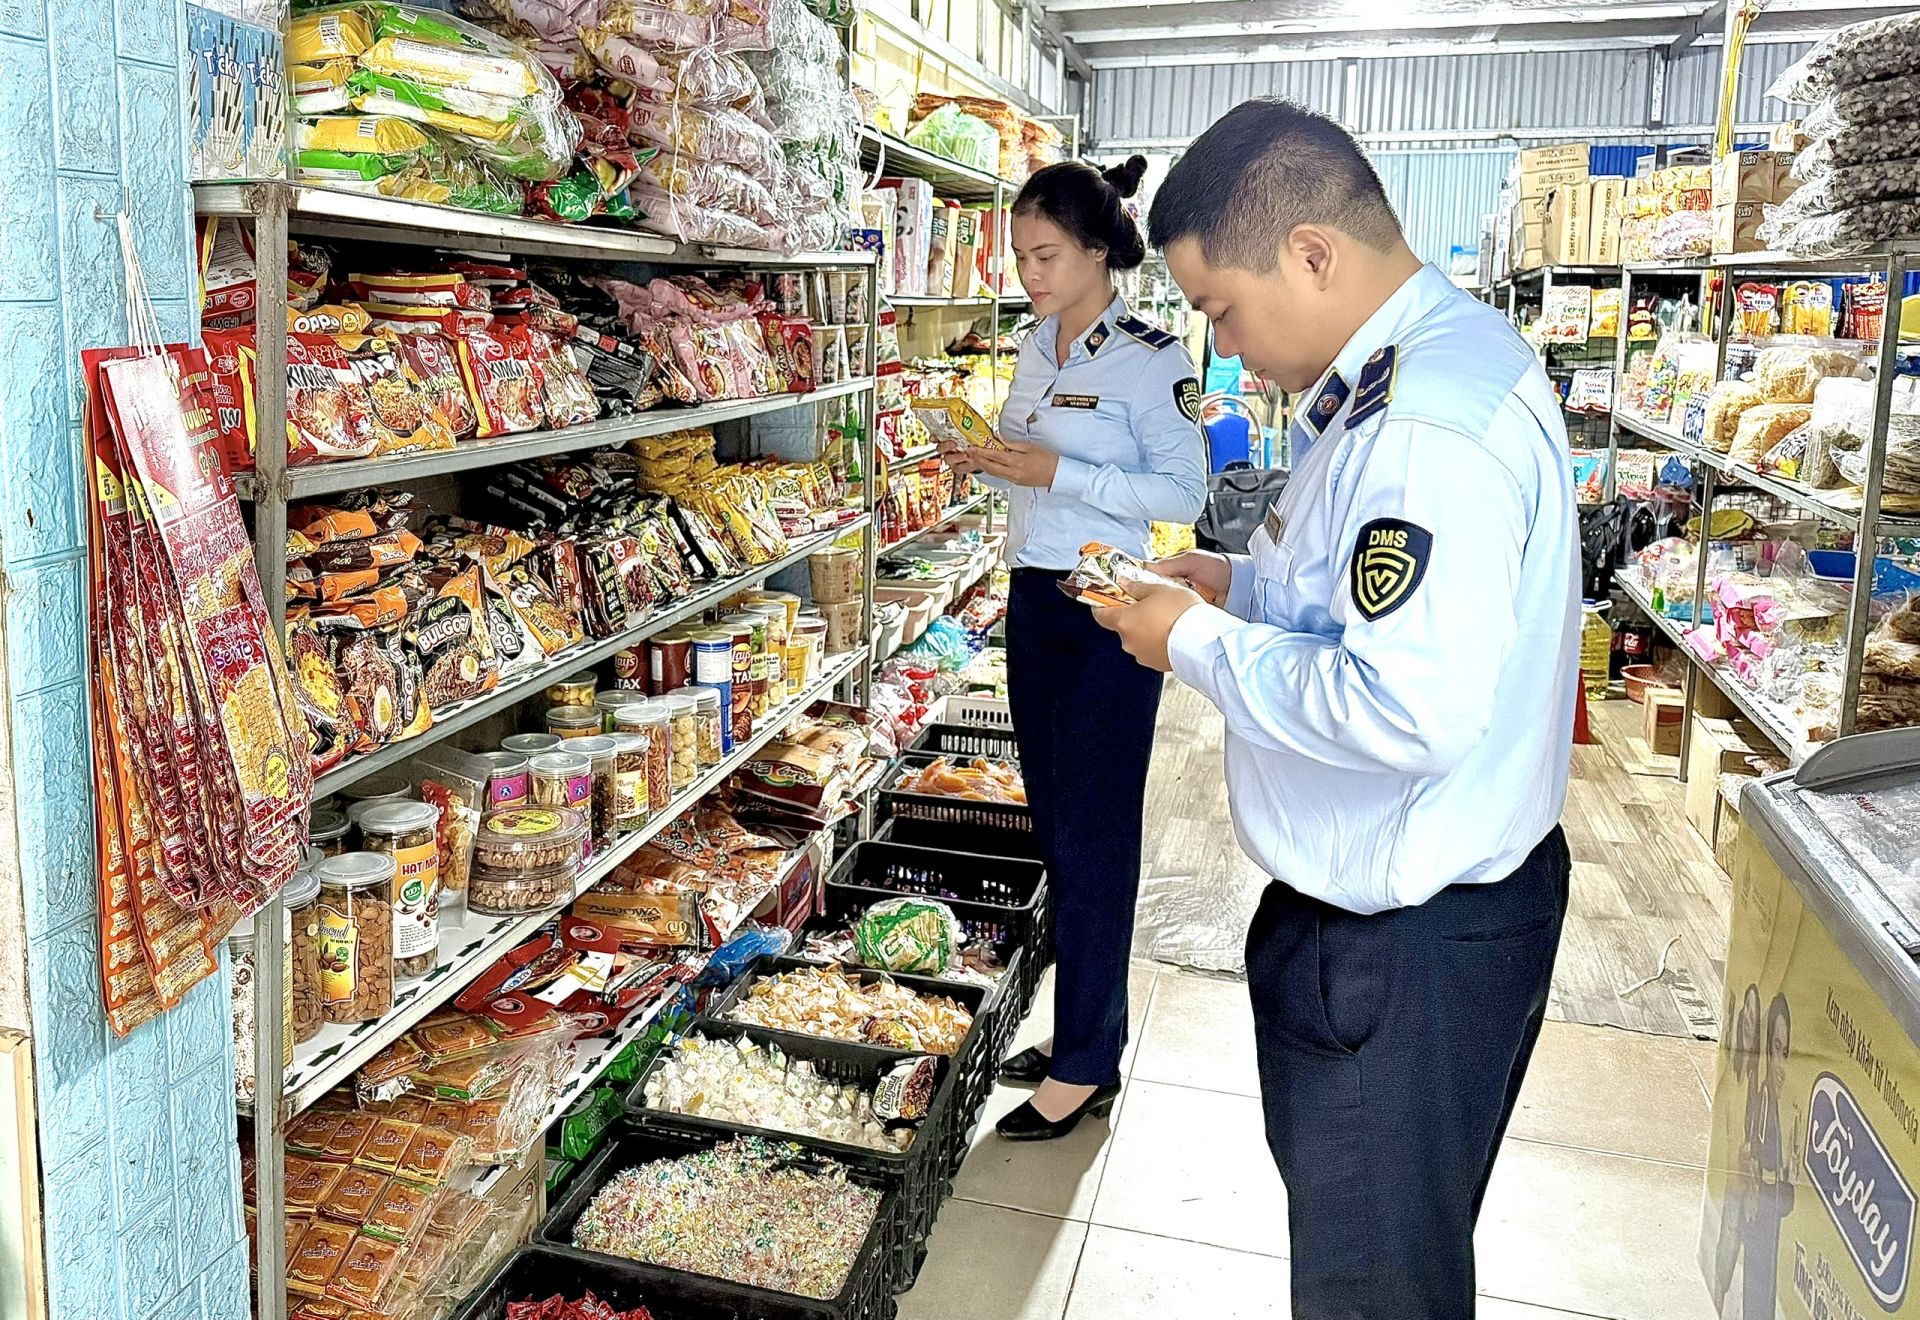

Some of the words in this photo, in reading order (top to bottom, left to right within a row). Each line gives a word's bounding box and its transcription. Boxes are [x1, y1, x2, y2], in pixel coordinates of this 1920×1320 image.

[960, 217, 970, 244] EURO
[777, 344, 794, 385] VOLCANO
[1369, 529, 1408, 548] DMS
[427, 597, 456, 621] KORENO
[418, 615, 471, 654] BULGOGI
[211, 640, 253, 670] Bento
[1826, 986, 1840, 1029] Kem
[1839, 1011, 1856, 1058] nhập
[1856, 1029, 1875, 1079] khẩu
[1874, 1059, 1883, 1093] từ
[1883, 1068, 1919, 1145] Indonesia
